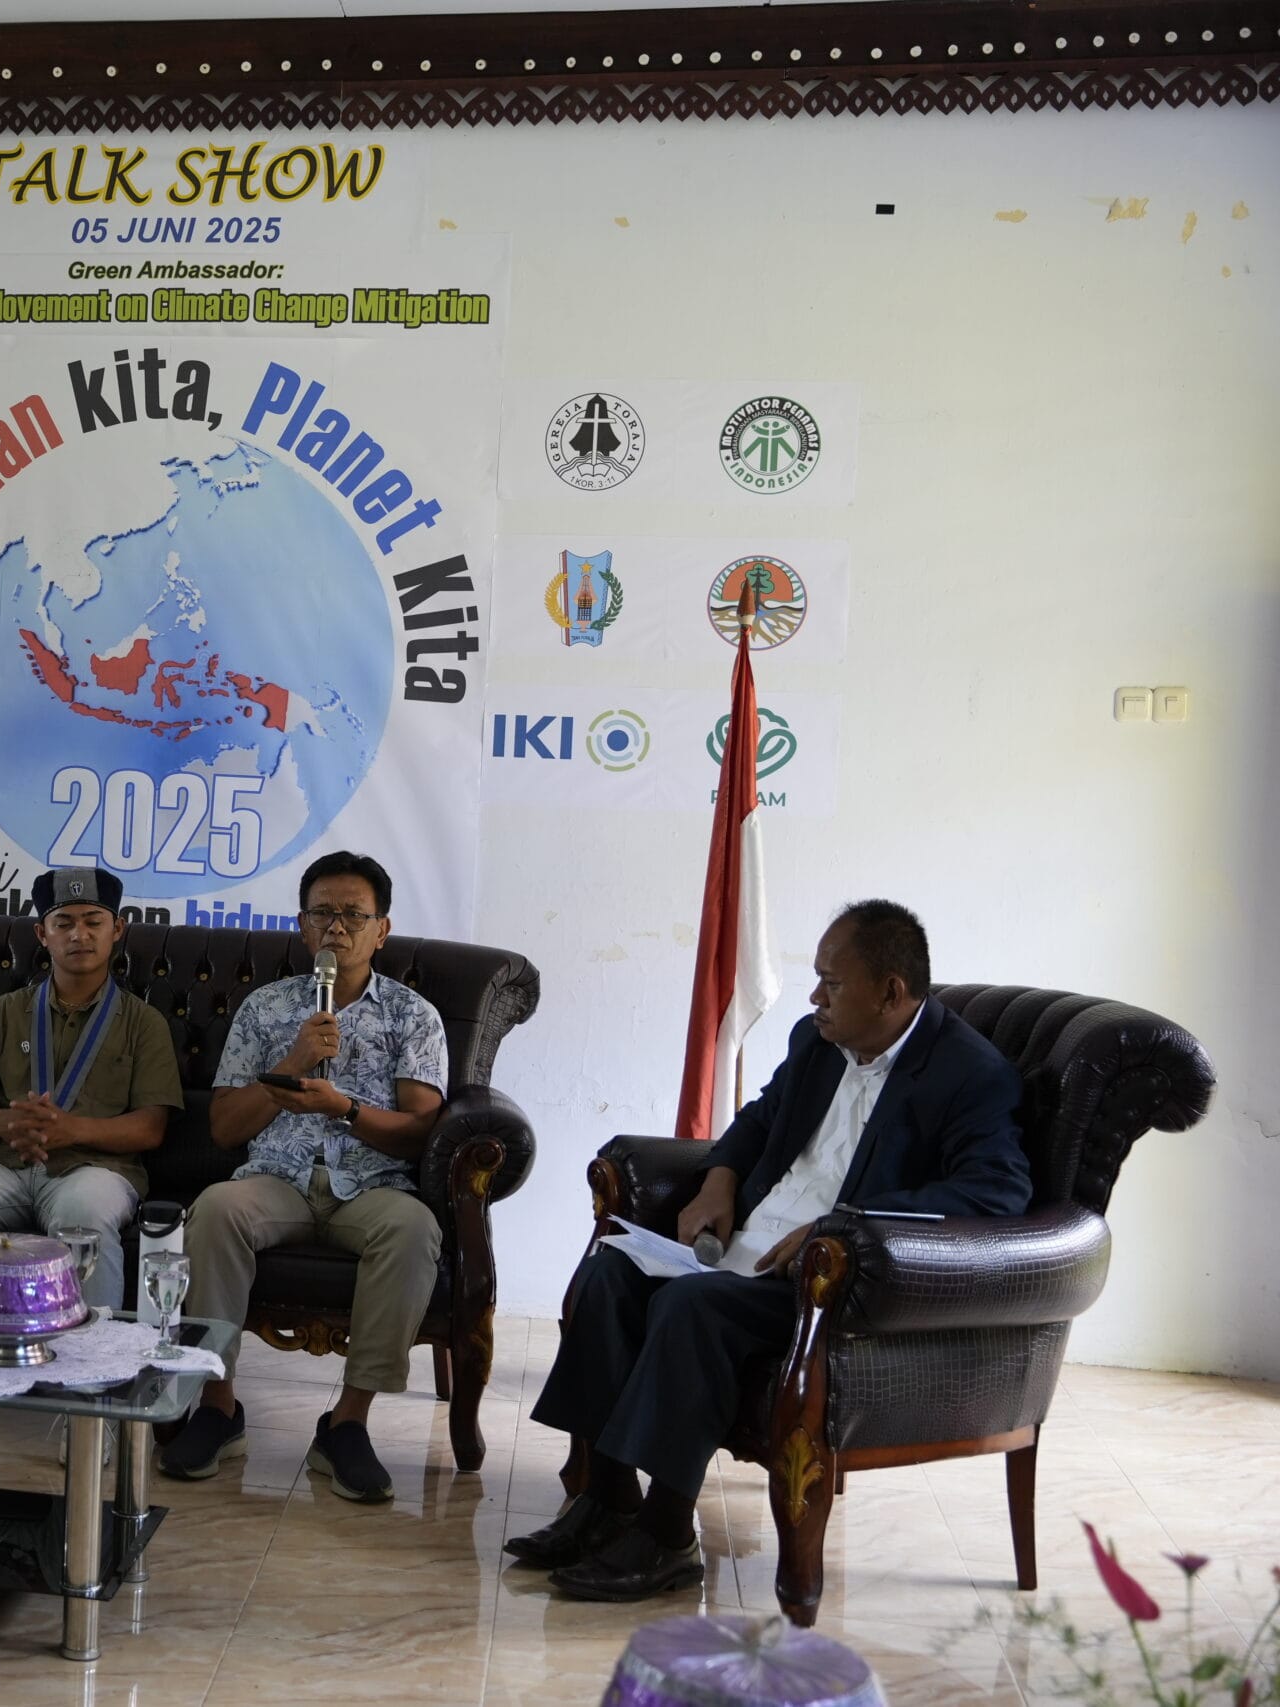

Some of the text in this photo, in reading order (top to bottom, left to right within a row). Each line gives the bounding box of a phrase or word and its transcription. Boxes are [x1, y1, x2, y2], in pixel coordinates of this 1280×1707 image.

[167, 142, 386, 207] SHOW
[70, 217, 282, 244] 05 JUNI 2025
[67, 260, 284, 281] Green Ambassador:
[114, 293, 148, 324] on
[151, 288, 250, 325] Climate
[253, 288, 348, 328] Change
[351, 288, 490, 328] Mitigation
[550, 402, 640, 463] GEREJA TORAJA
[721, 398, 819, 448] MOTIVATOR PENAMAS
[729, 462, 808, 489] INDONESIA
[67, 347, 222, 433] kita,
[241, 361, 443, 556] Planet
[393, 554, 479, 704] Kita
[492, 714, 574, 760] IKI
[47, 766, 265, 878] 2025
